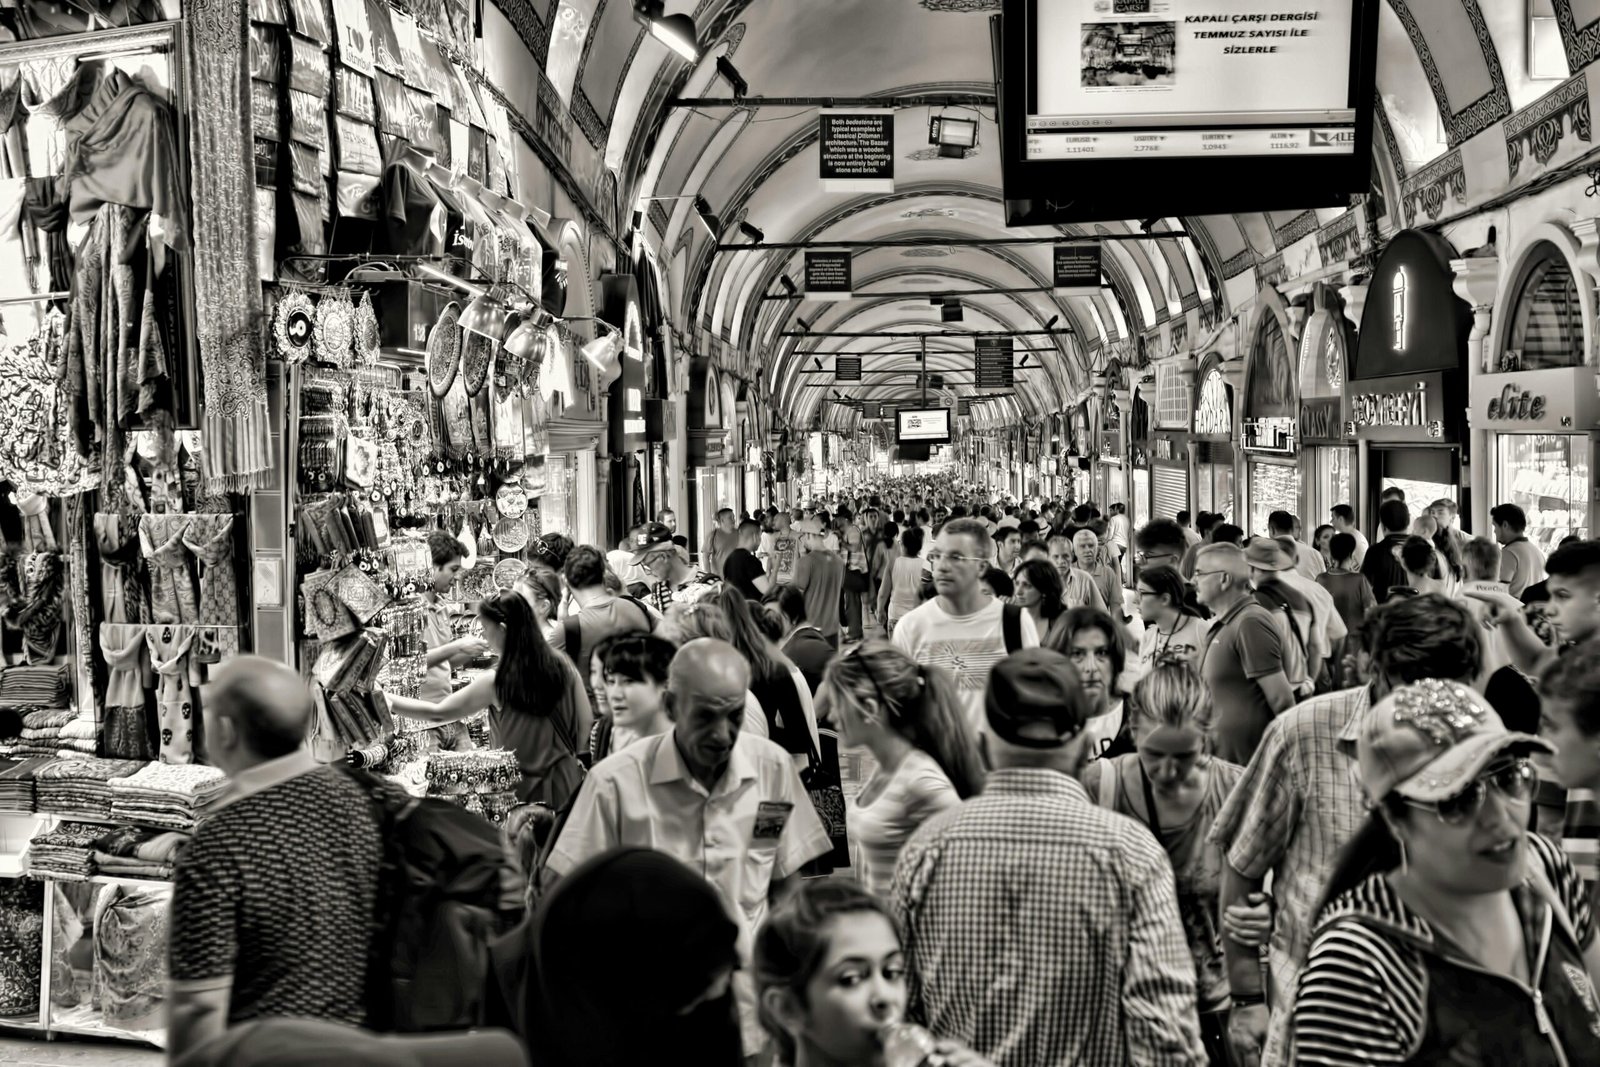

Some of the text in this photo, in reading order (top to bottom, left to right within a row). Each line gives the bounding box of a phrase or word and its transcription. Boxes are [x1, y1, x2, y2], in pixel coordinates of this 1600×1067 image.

[1184, 11, 1318, 24] KAPALI ÇARŞI DERGİSİ
[1193, 27, 1308, 39] TEMMUZ SAYISI İLE
[1223, 44, 1277, 54] SİZLERLE
[1487, 382, 1546, 421] elite
[1301, 405, 1332, 439] CLASSY
